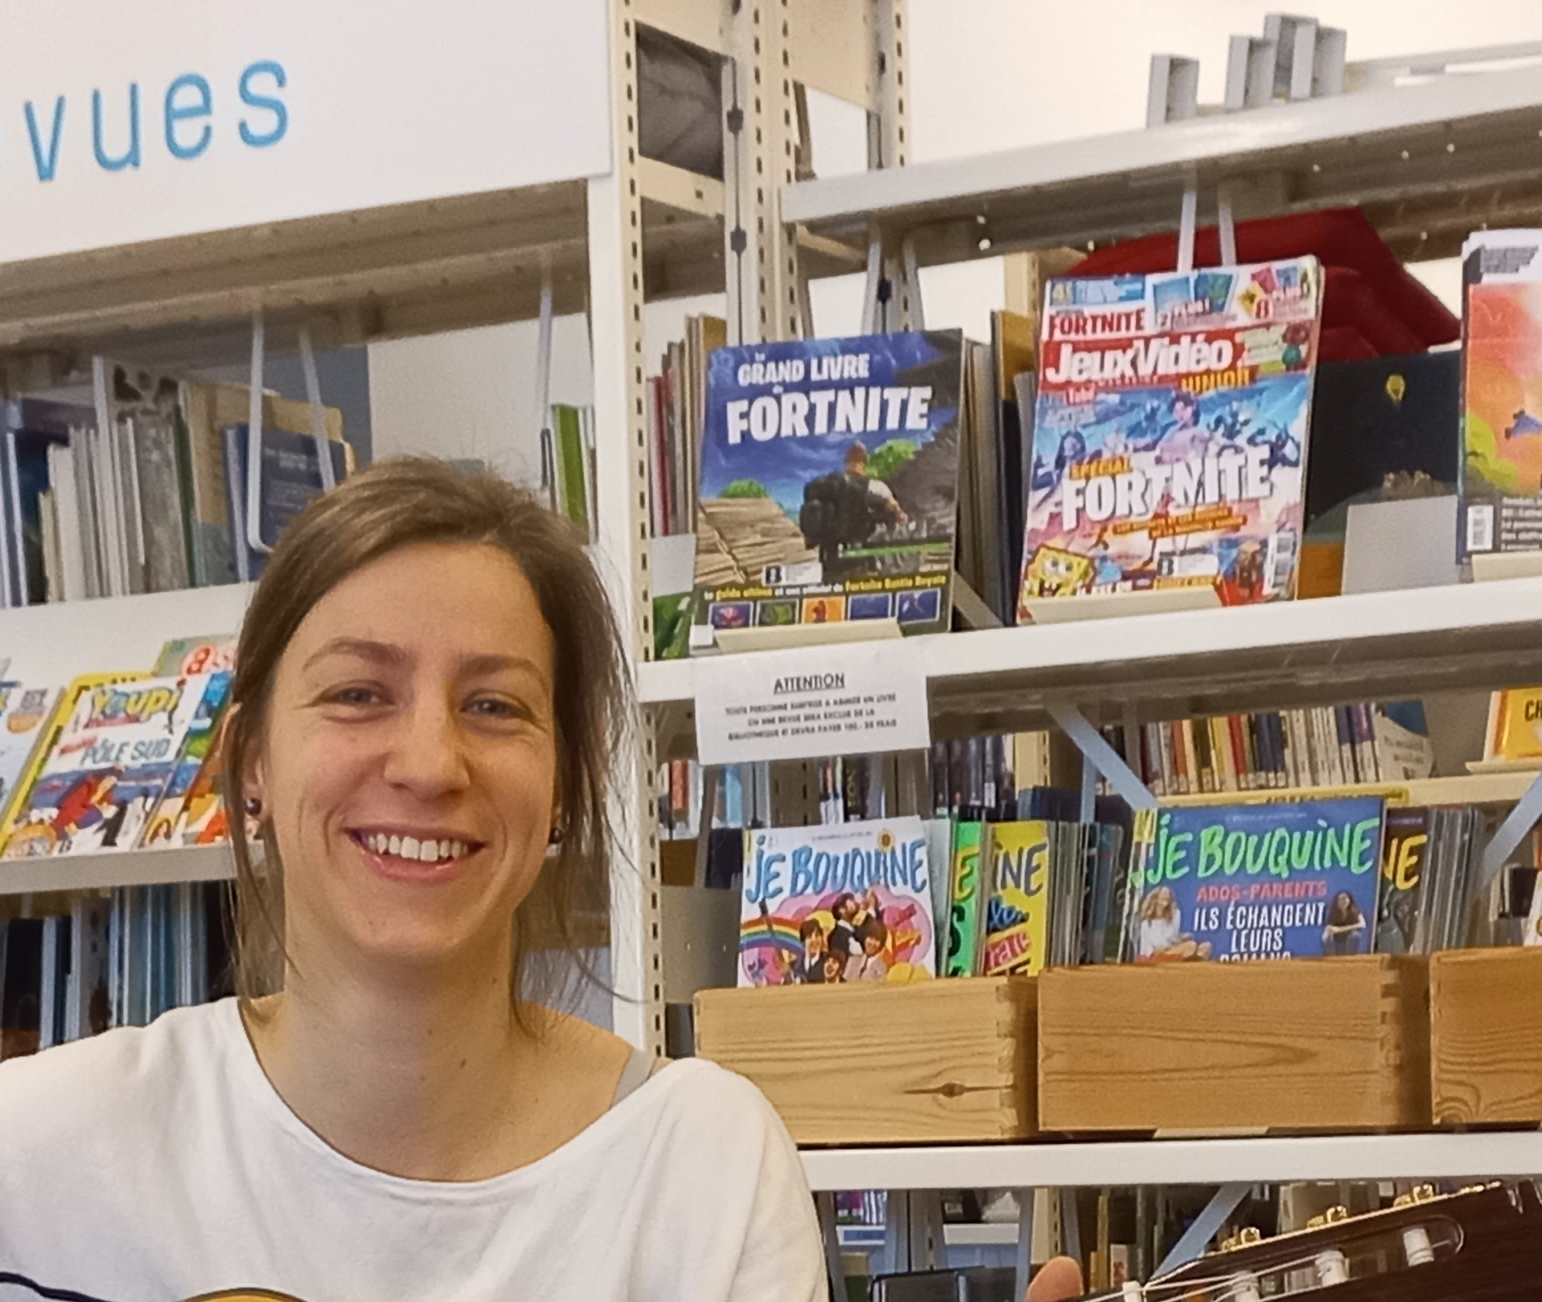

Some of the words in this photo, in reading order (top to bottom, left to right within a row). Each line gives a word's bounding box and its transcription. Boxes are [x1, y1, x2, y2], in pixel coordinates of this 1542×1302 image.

[1048, 307, 1146, 337] FORTNITE
[737, 358, 806, 387] GRAND
[809, 352, 871, 382] LIVRE
[1044, 331, 1234, 384] JeuxVidéo
[725, 385, 934, 447] FORTNITE
[1061, 443, 1273, 533] FORTNITE
[773, 672, 845, 695] ATTENTION
[79, 736, 131, 768] PÔLE
[130, 736, 172, 764] SUD
[1146, 813, 1193, 886] JE
[1197, 817, 1381, 879] BOUQUINE
[745, 834, 787, 904] JE
[788, 838, 929, 898] BOUQUINE
[1193, 905, 1221, 932] ILS
[1225, 901, 1326, 930] ÉCHANGENT
[1230, 929, 1284, 953] LEURS
